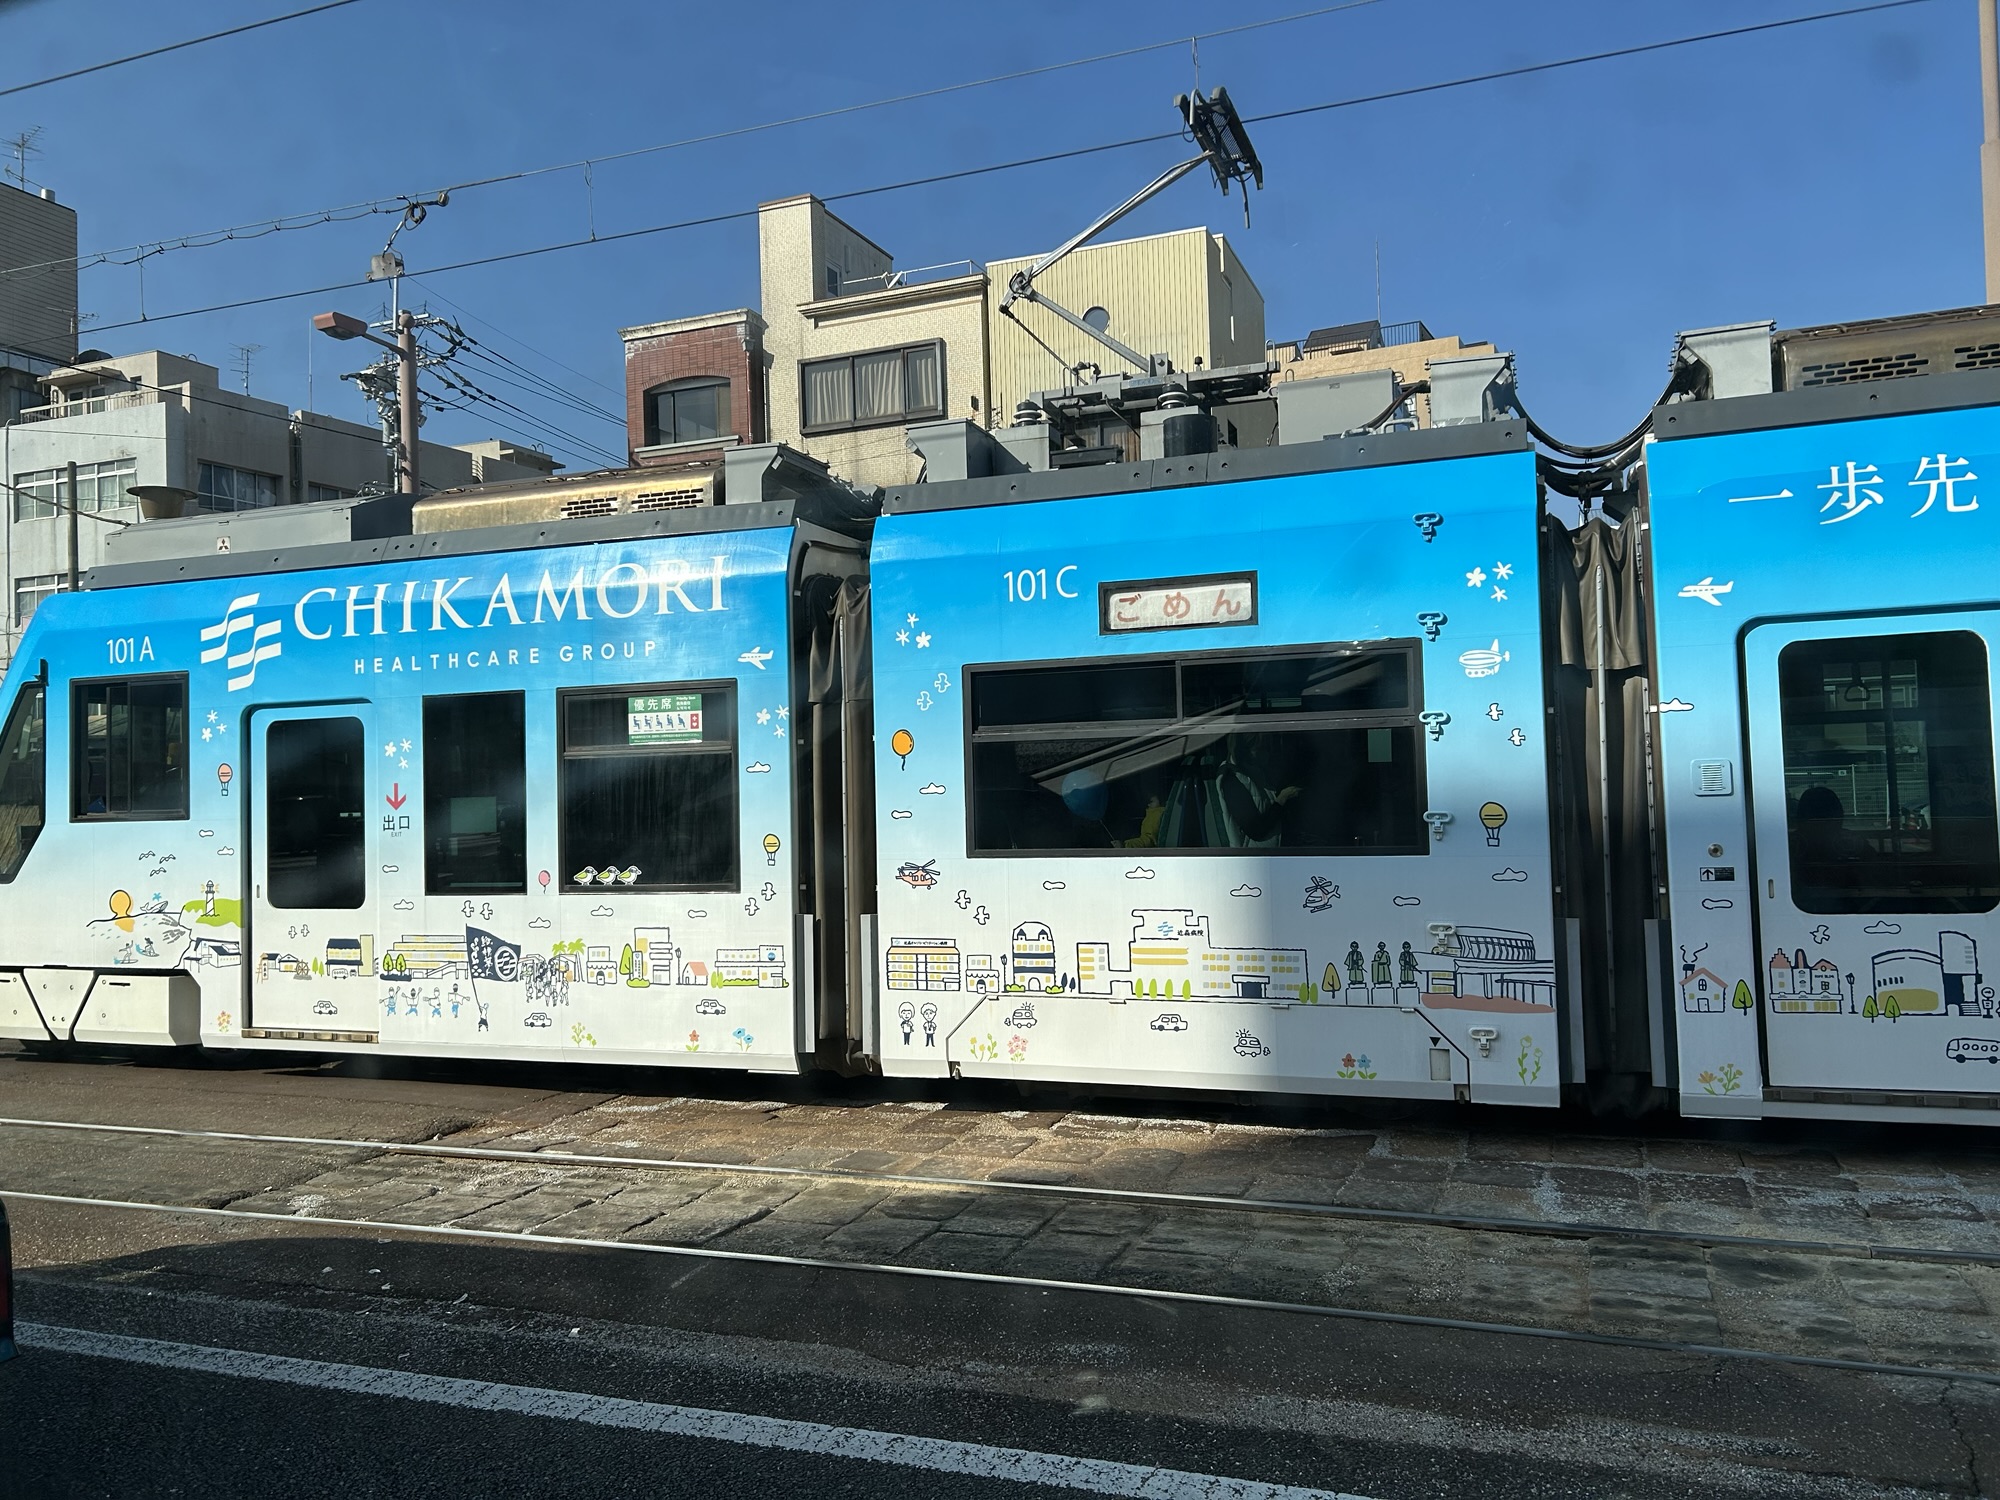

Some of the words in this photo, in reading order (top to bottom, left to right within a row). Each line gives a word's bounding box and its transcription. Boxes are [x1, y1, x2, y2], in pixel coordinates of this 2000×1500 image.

[1728, 453, 1980, 525] 一歩先
[294, 556, 729, 640] CHIKAMORI
[1117, 588, 1241, 622] ごめん
[354, 649, 540, 675] HEALTHCARE
[559, 641, 656, 662] GROUP
[634, 698, 672, 711] 優先席
[382, 815, 410, 831] 出口
